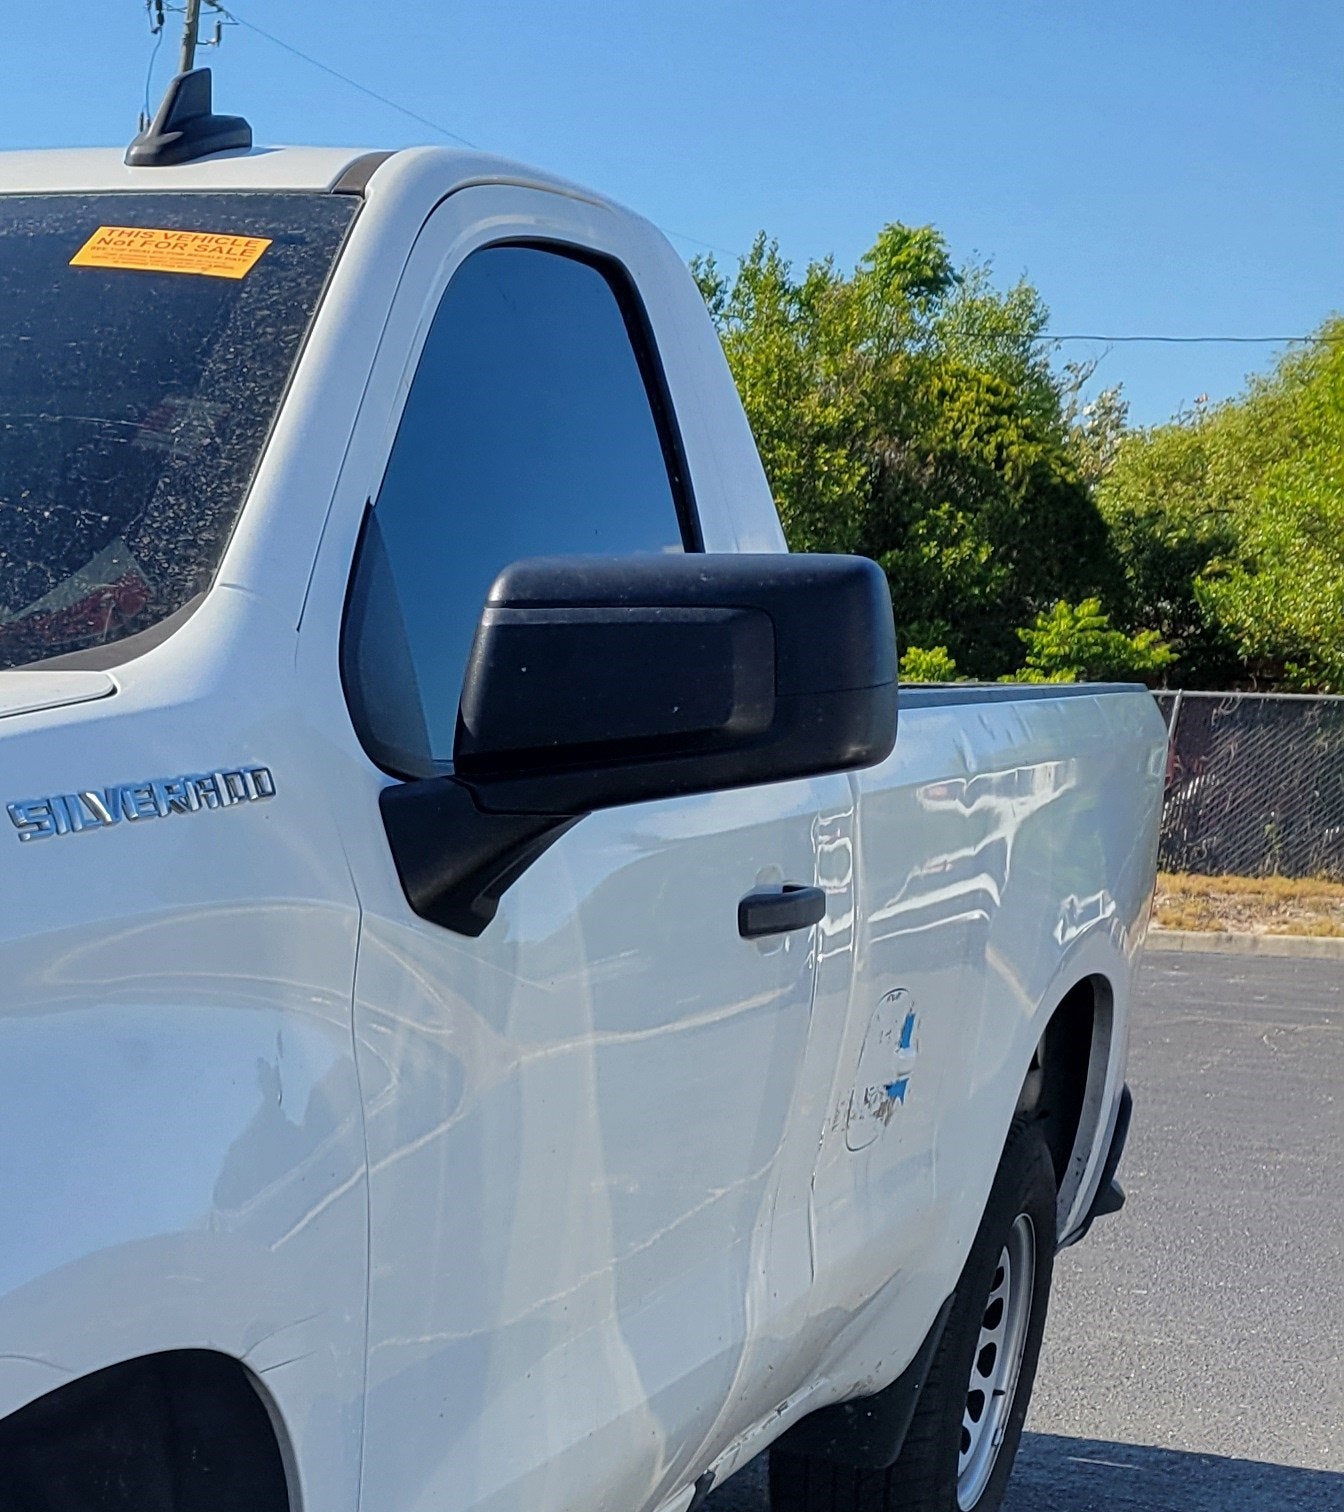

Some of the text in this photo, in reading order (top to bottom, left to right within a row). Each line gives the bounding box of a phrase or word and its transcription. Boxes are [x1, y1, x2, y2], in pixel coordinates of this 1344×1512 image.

[106, 229, 261, 248] THIS VEHICLE
[139, 239, 189, 251] FOR
[193, 244, 257, 257] SALE
[6, 766, 277, 843] SILVERADO
